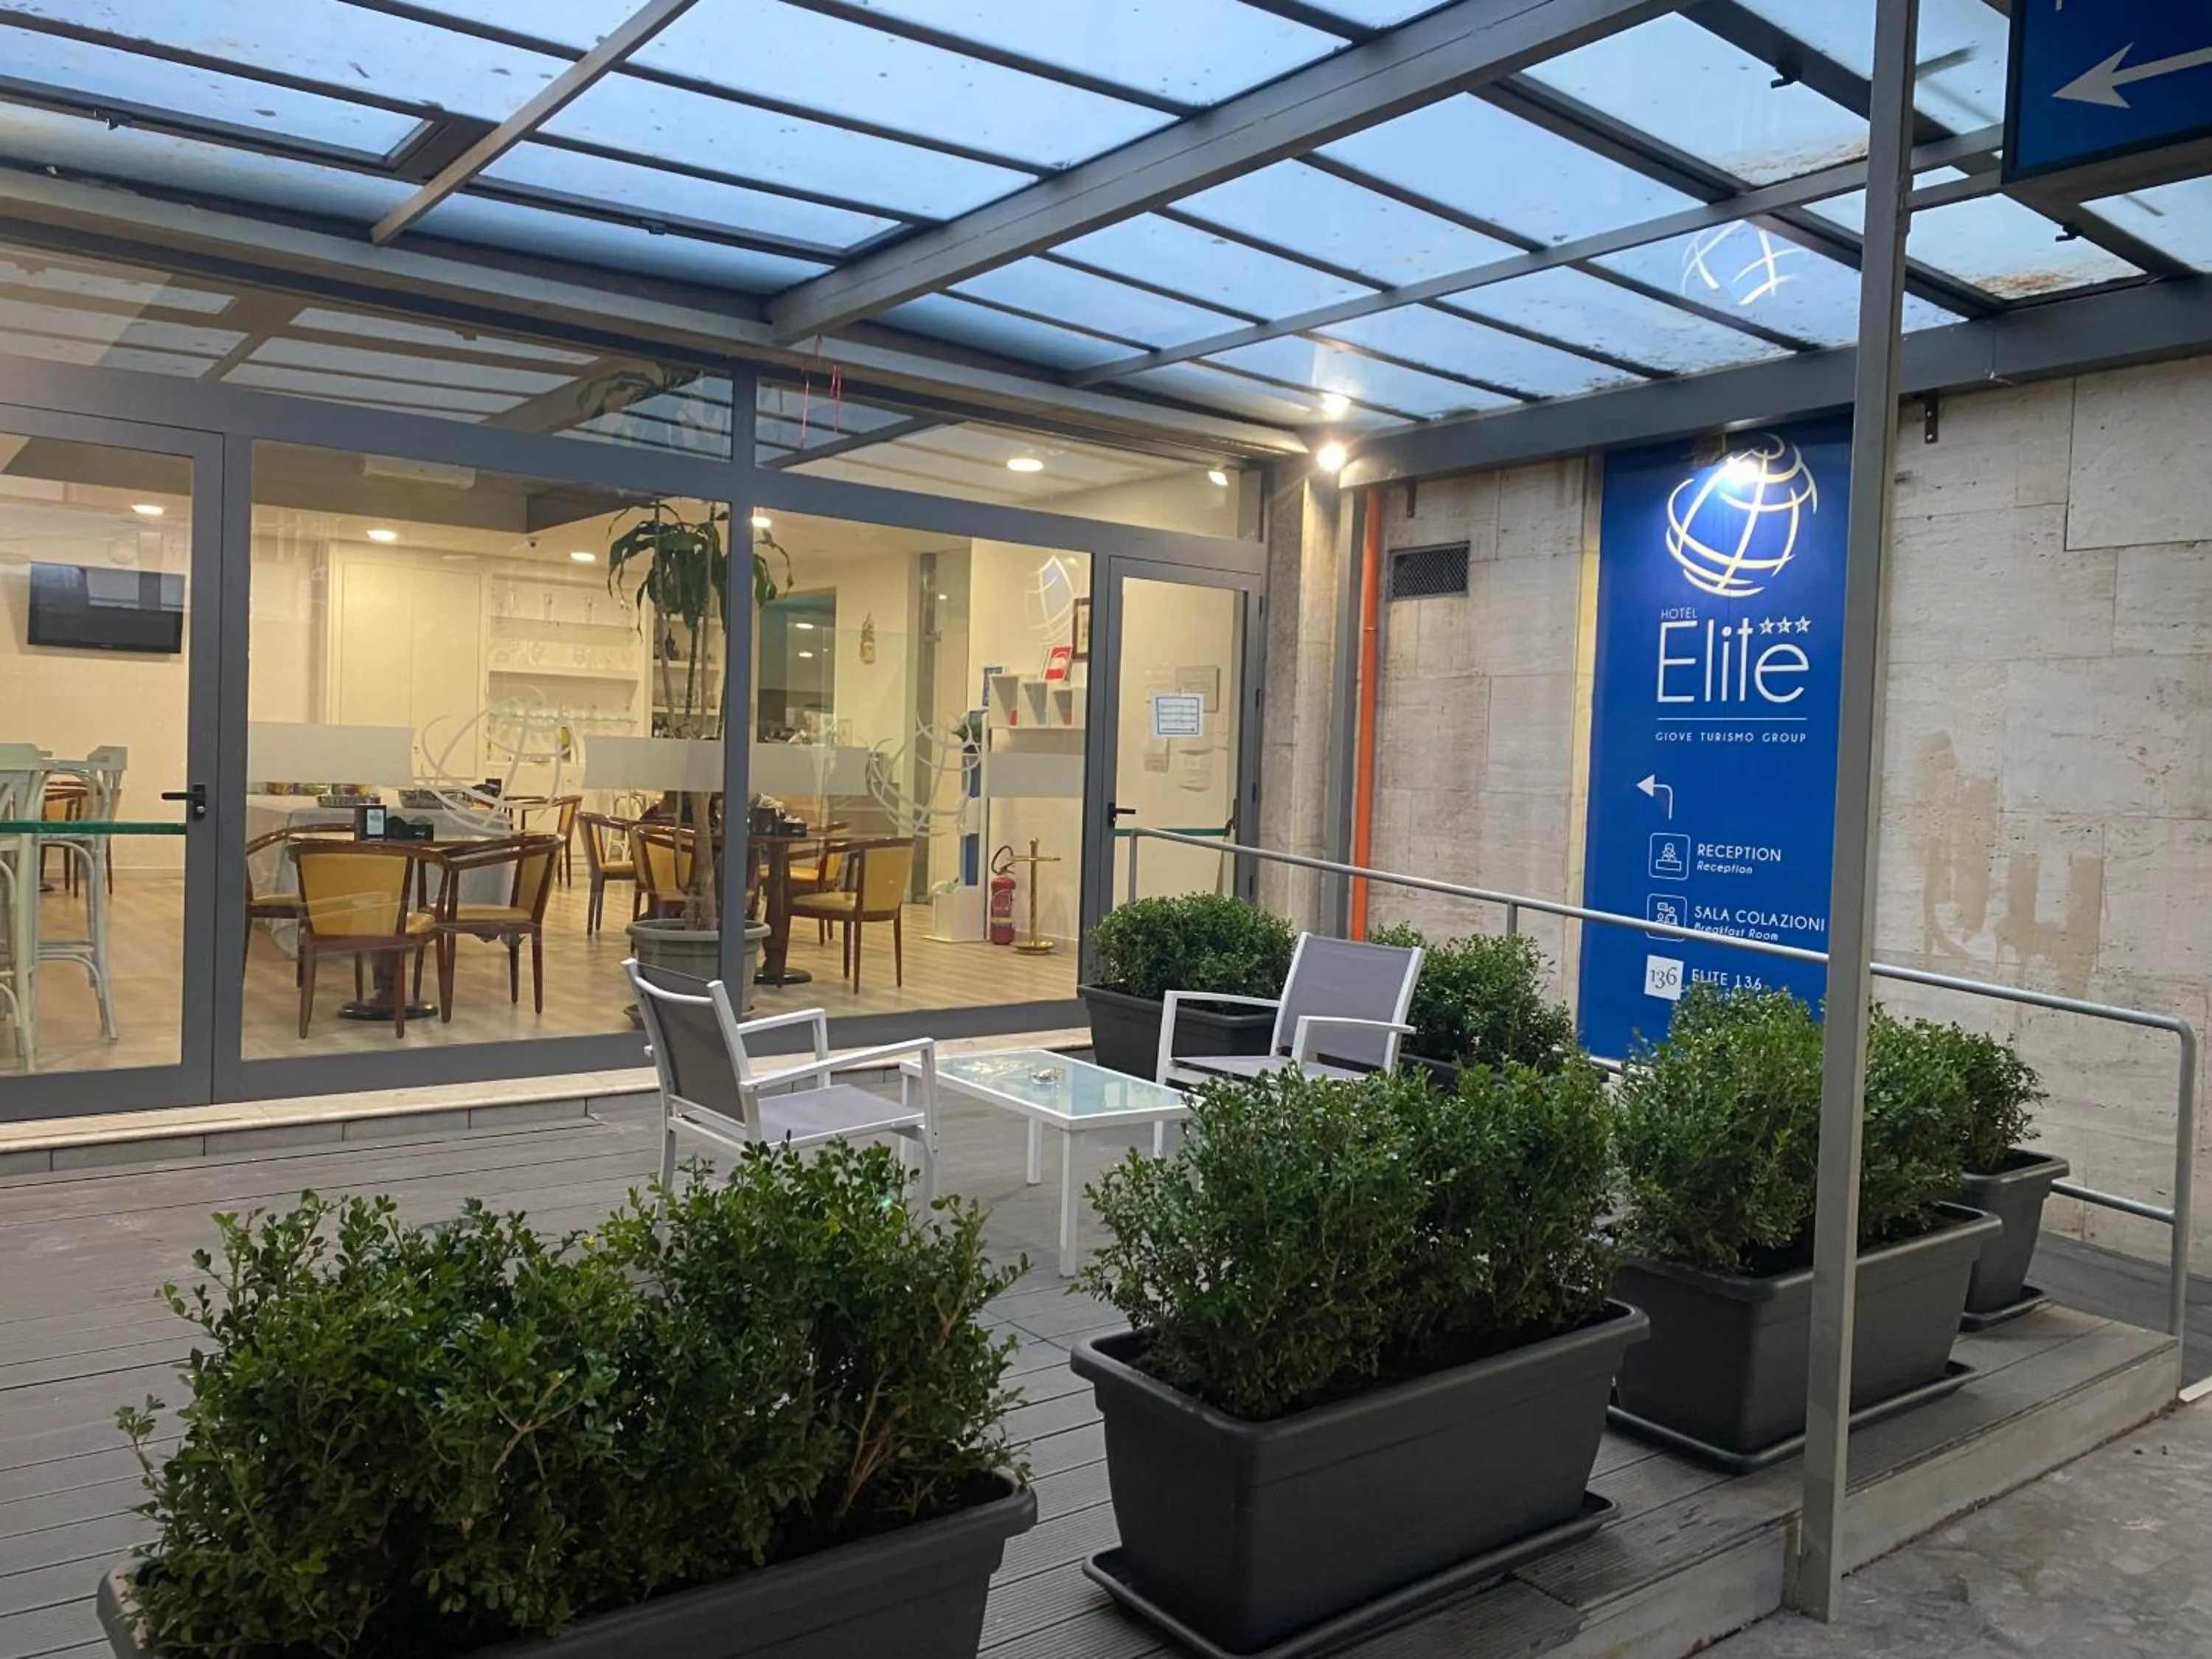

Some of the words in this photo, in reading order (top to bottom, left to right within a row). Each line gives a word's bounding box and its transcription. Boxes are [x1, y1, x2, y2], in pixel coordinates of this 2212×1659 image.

[1661, 608, 1697, 619] HOTEL
[1658, 618, 1809, 703] Elite
[1655, 731, 1693, 742] GIOVE
[1700, 731, 1754, 742] TURISMO
[1762, 732, 1806, 743] GROUP
[1697, 844, 1781, 861] RECEPTION
[1697, 861, 1752, 874] Reception
[1694, 905, 1730, 922] SALA
[1736, 910, 1825, 931] COLAZIONI
[1748, 928, 1779, 942] Room
[1649, 967, 1678, 989] 136
[1691, 968, 1728, 986] ELITE
[1734, 974, 1762, 992] 136
